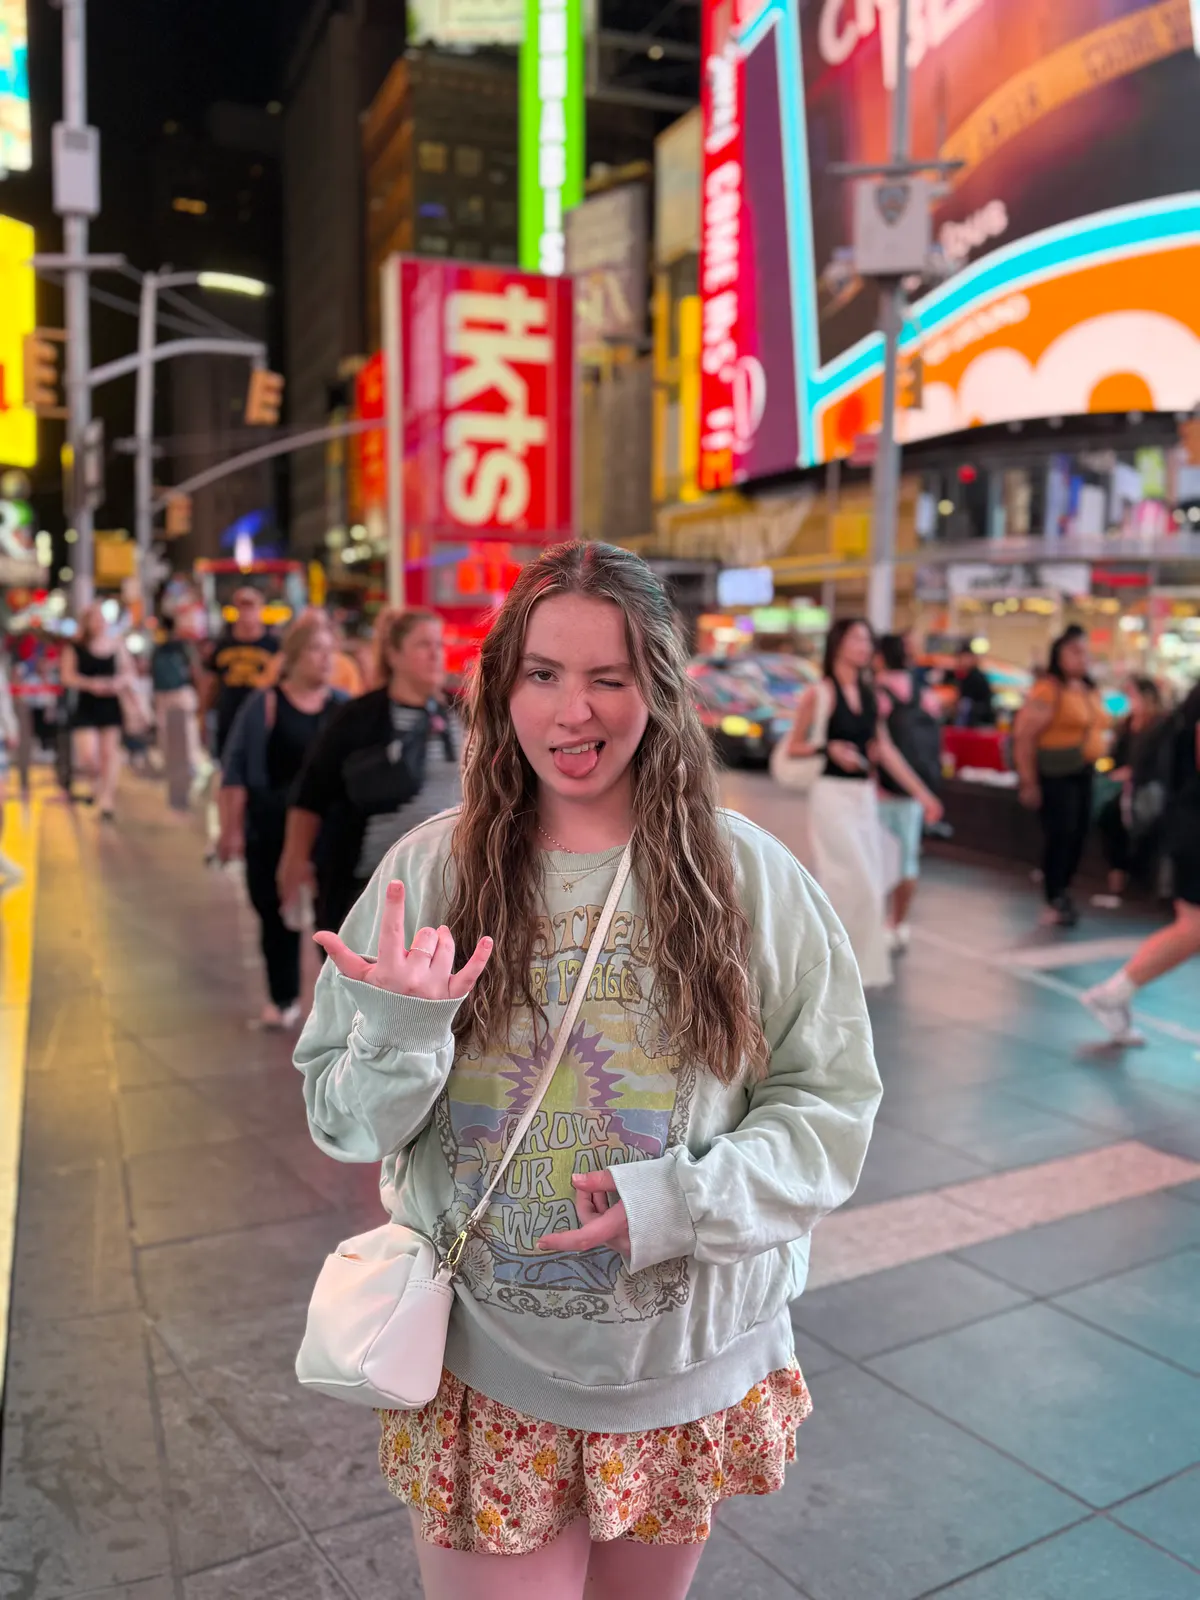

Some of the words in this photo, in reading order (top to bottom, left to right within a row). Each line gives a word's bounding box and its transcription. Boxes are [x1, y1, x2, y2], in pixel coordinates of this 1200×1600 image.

[443, 284, 554, 526] tkts
[501, 1110, 613, 1156] GROW
[502, 1198, 581, 1251] WA
